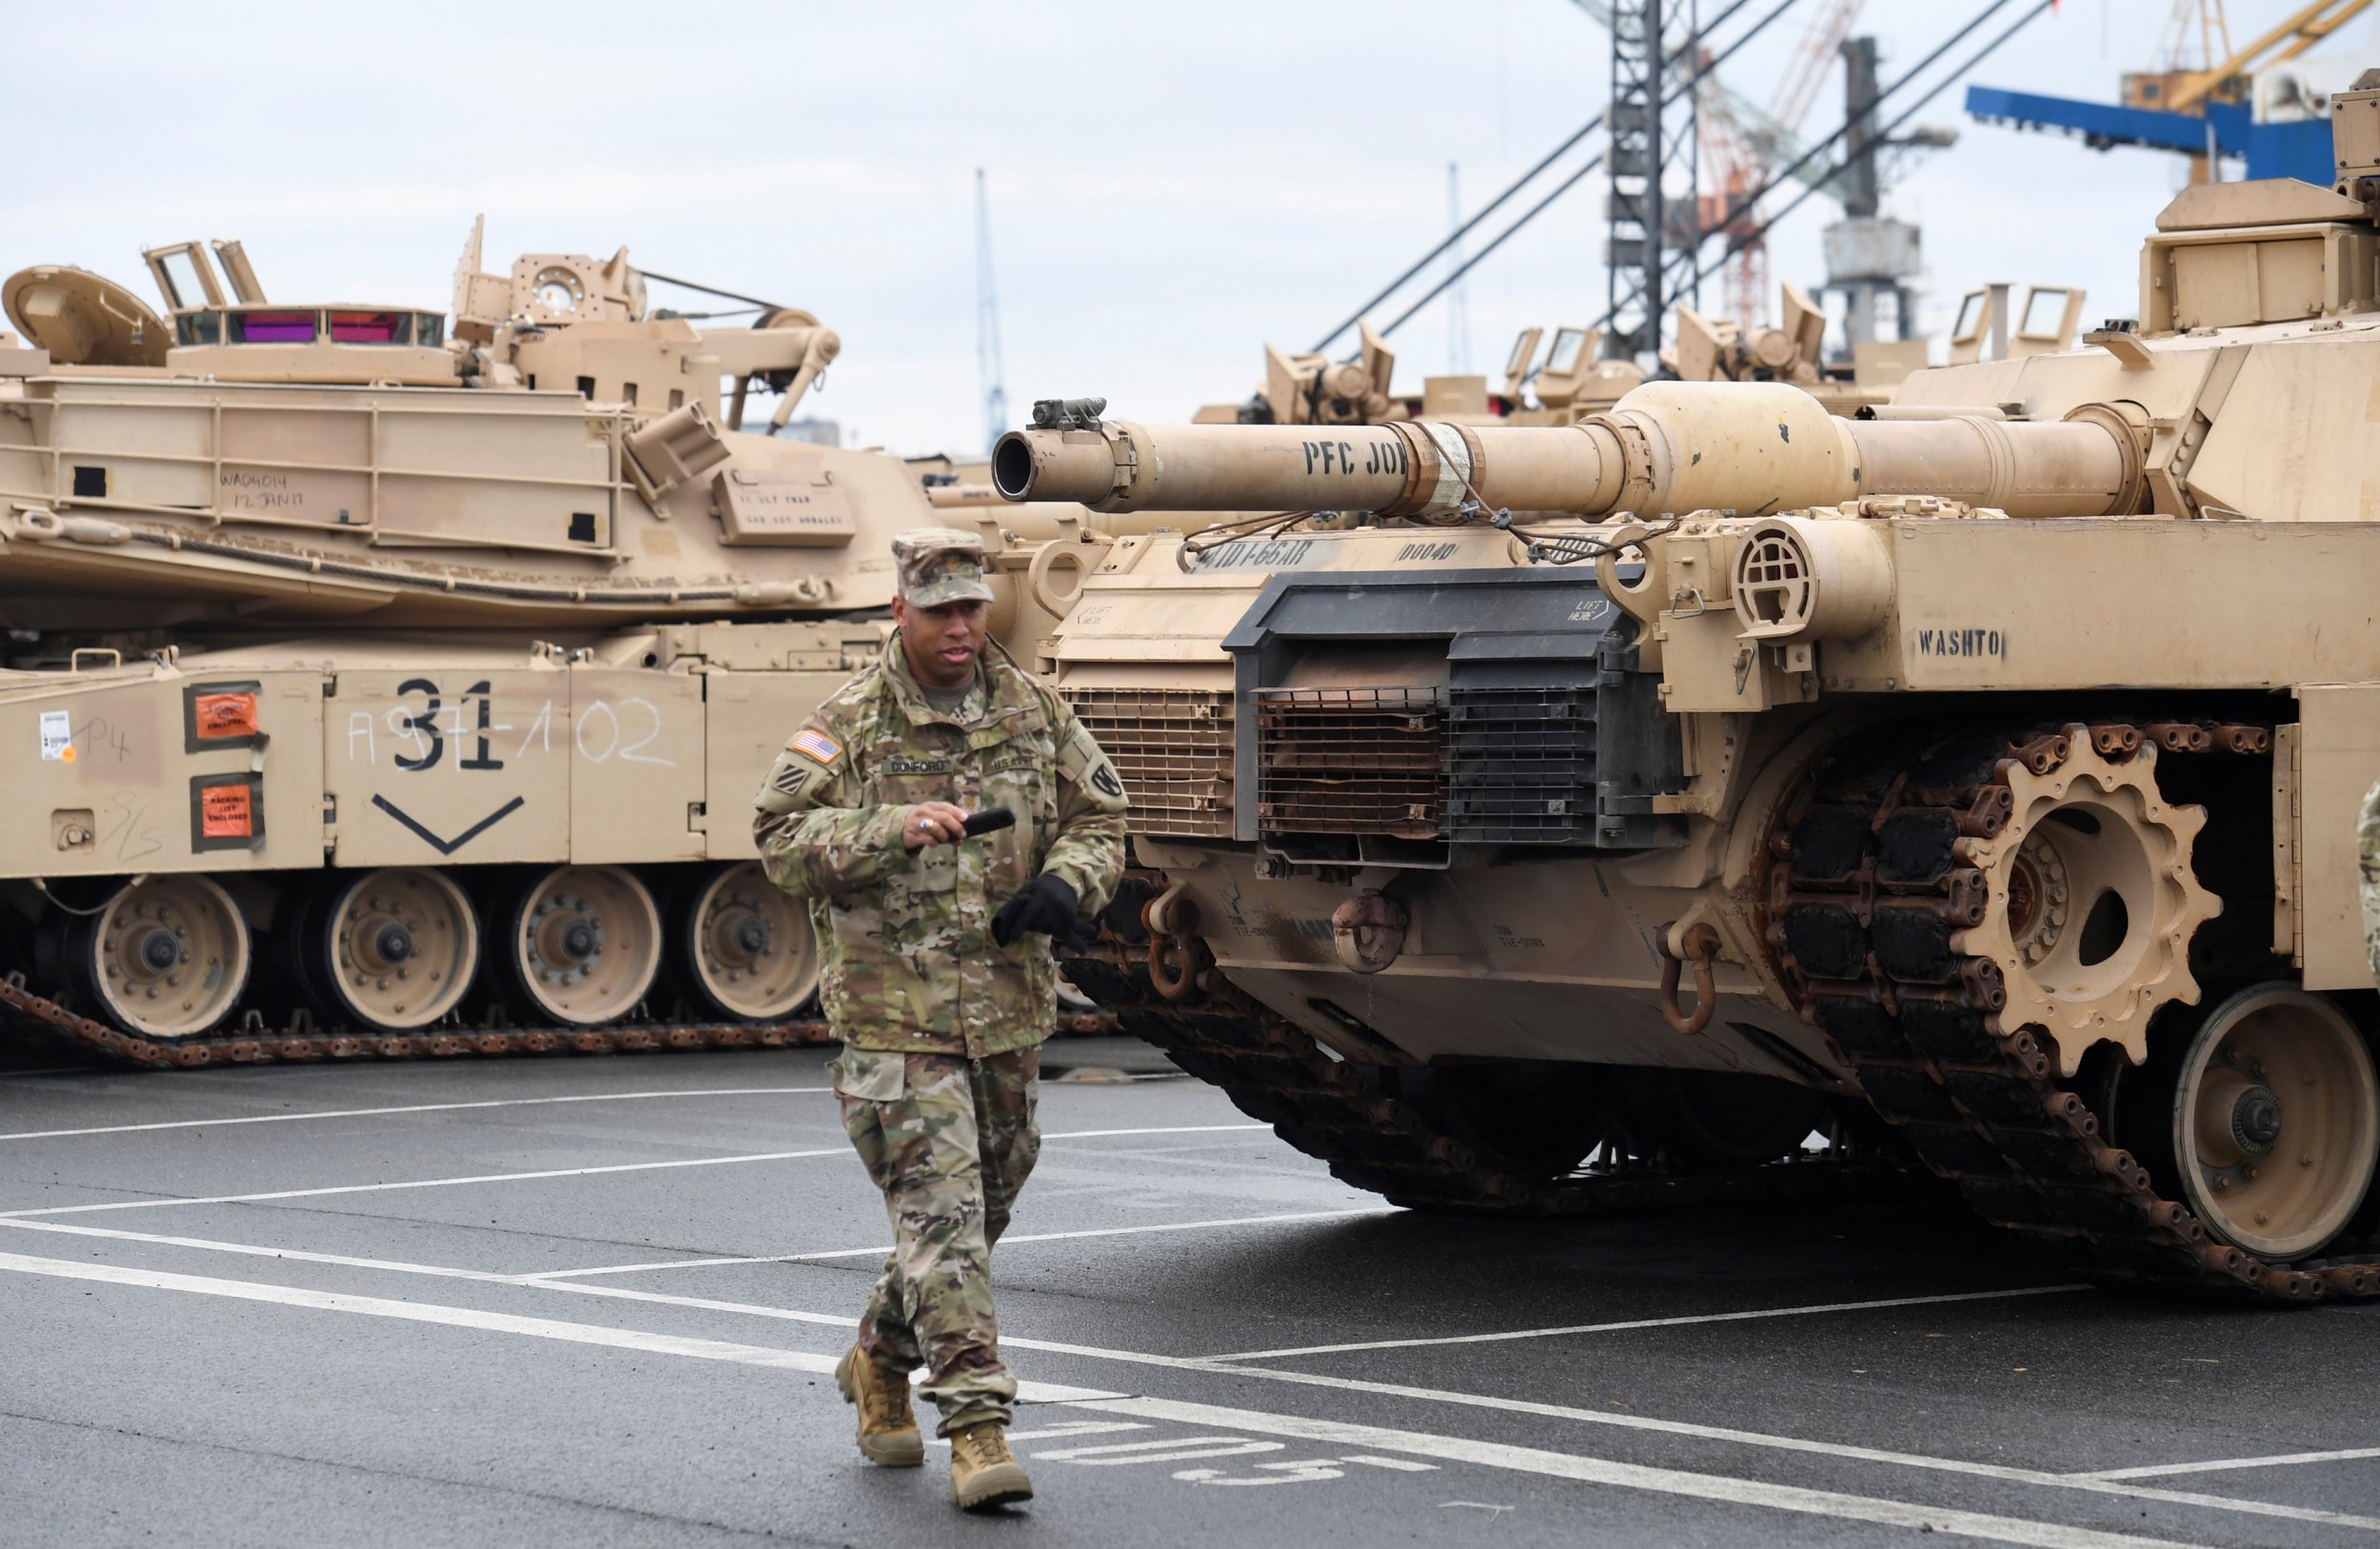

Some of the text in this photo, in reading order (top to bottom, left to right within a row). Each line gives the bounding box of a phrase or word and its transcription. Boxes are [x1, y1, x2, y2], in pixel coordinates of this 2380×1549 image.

[1302, 442, 1355, 475] PFC
[1576, 600, 1603, 610] LIFT
[1918, 629, 2000, 658] WASHTO
[394, 678, 504, 771] 31
[891, 761, 943, 772] DUNFORD
[208, 813, 248, 822] ENCLOSED
